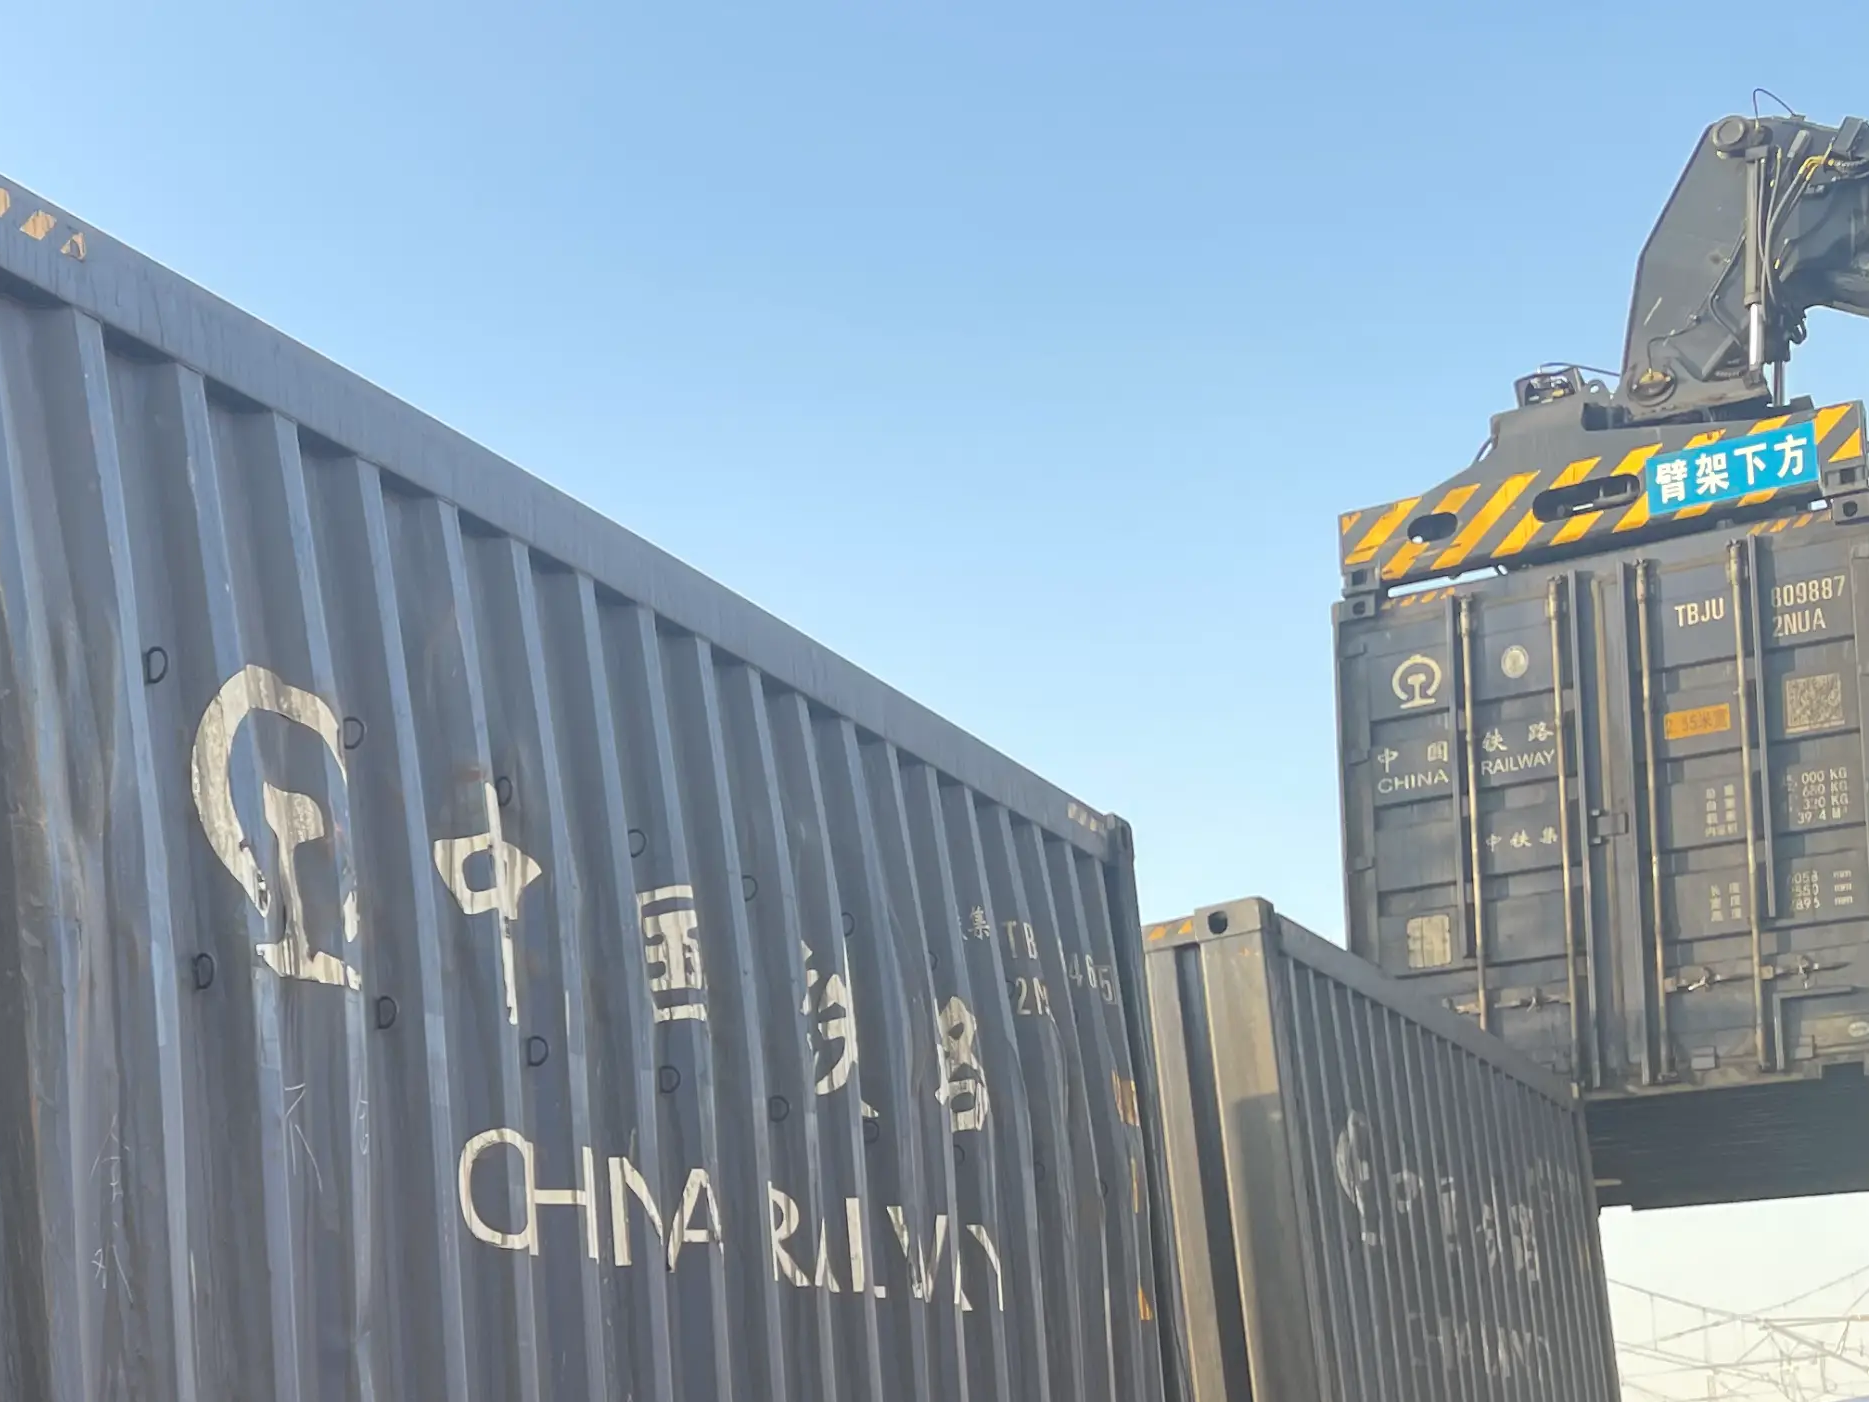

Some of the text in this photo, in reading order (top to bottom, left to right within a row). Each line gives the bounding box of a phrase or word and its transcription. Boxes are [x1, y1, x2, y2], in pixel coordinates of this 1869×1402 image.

[1655, 433, 1808, 504] 臂架下方
[1674, 597, 1725, 627] TBJU
[1772, 608, 1826, 637] 2NUA
[1377, 749, 1555, 794] CHINA RAILWAY
